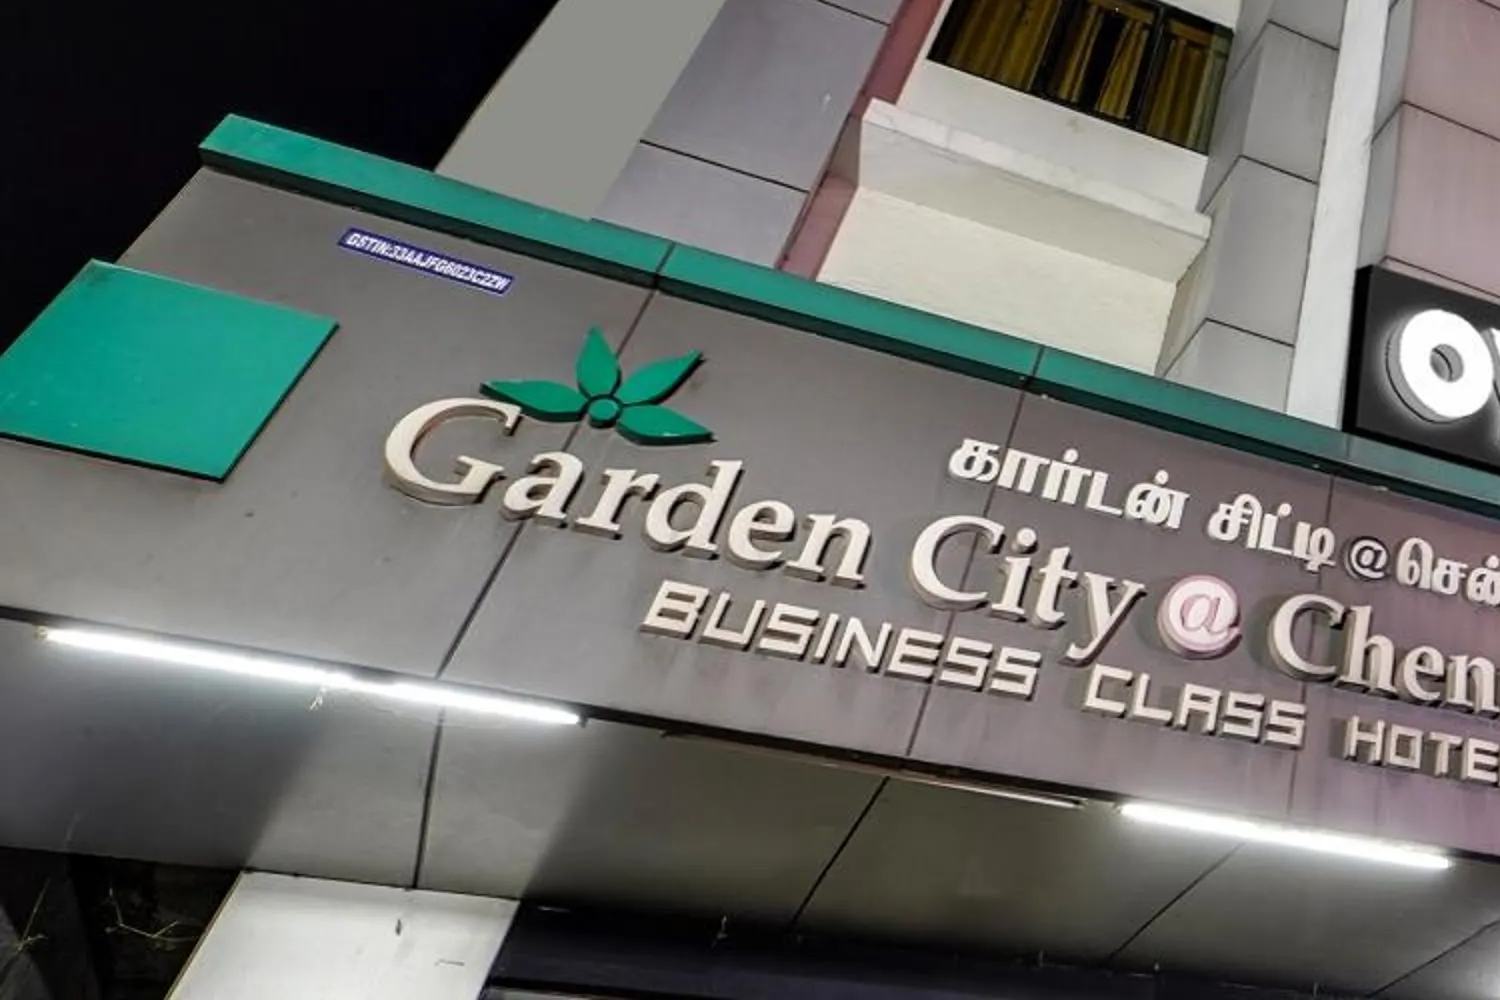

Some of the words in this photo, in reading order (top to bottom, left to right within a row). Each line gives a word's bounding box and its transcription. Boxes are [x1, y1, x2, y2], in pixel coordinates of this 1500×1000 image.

[385, 397, 871, 588] Garden
[911, 515, 1146, 665] City
[949, 438, 1190, 529] கார்டன்
[1207, 493, 1337, 572] சிட்டி
[640, 579, 1042, 700] BUSINESS
[1083, 663, 1307, 750] CLASS
